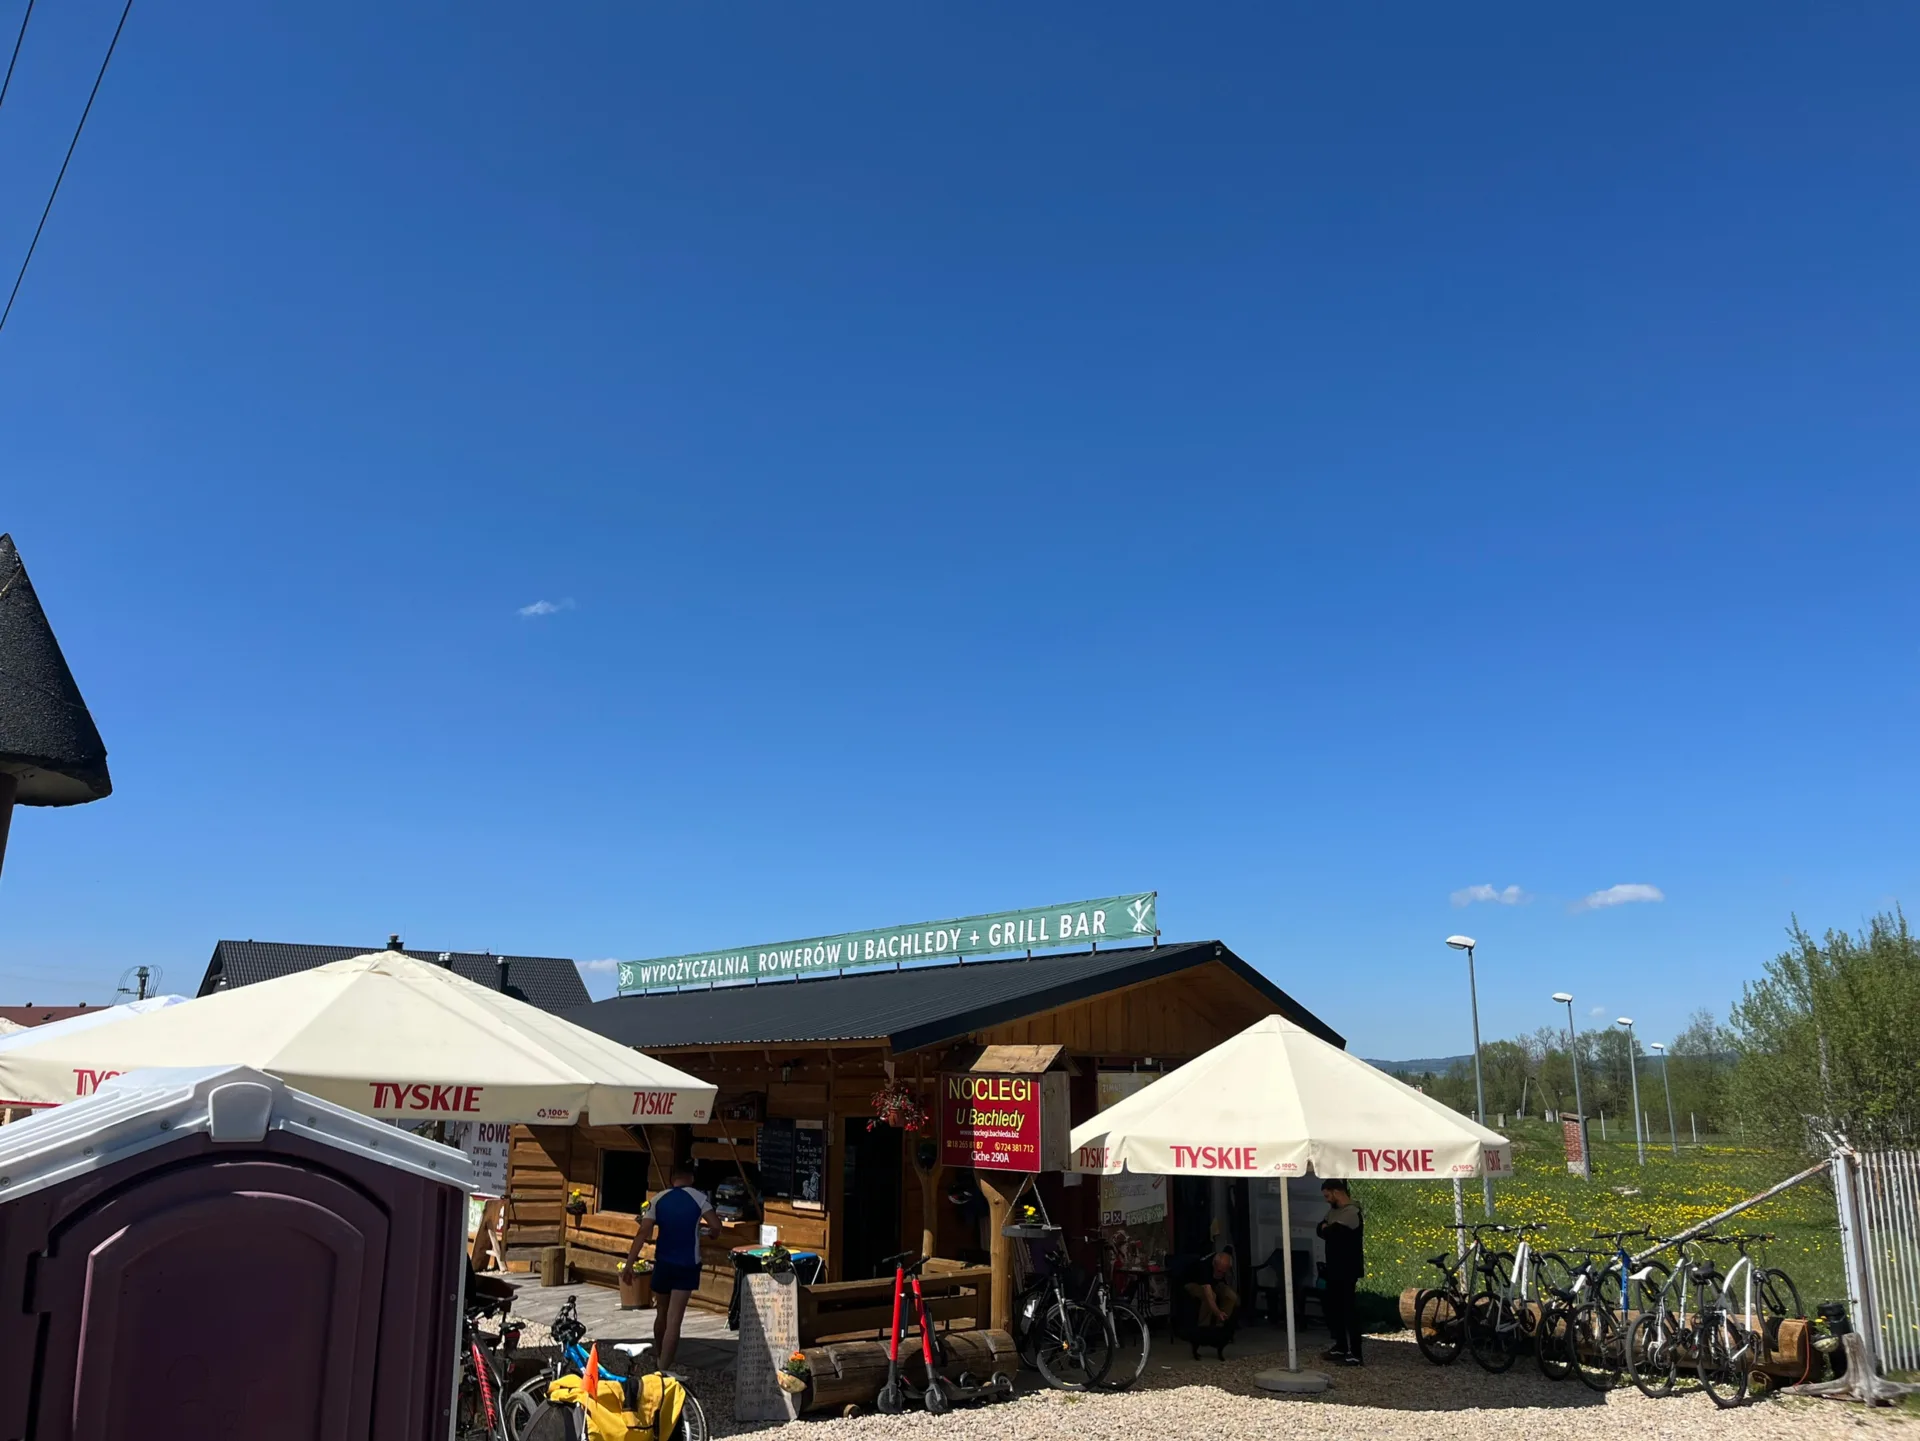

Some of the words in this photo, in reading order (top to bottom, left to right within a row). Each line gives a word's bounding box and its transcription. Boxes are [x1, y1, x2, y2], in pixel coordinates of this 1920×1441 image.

[641, 955, 750, 984] WYPOŻYCZALNIA
[758, 942, 841, 972] ROWERÓW
[847, 941, 859, 962] U
[865, 928, 962, 960] BACHLEDY
[969, 933, 980, 946] +
[988, 917, 1049, 946] GRILL
[1059, 910, 1106, 939] BAR
[369, 1082, 484, 1112] TYSKIE
[948, 1078, 1032, 1102] NOCLEGI
[632, 1092, 677, 1115] TYSKIE
[956, 1108, 966, 1125] U
[968, 1108, 1025, 1132] Bachledy
[971, 1150, 990, 1162] Ciche
[991, 1152, 1010, 1163] 290A
[1000, 1143, 1011, 1152] 724
[1023, 1145, 1035, 1153] 712
[1080, 1147, 1110, 1169] TYSKIE
[1169, 1145, 1258, 1170] TYSKIE
[1352, 1149, 1435, 1172] TYSKIE
